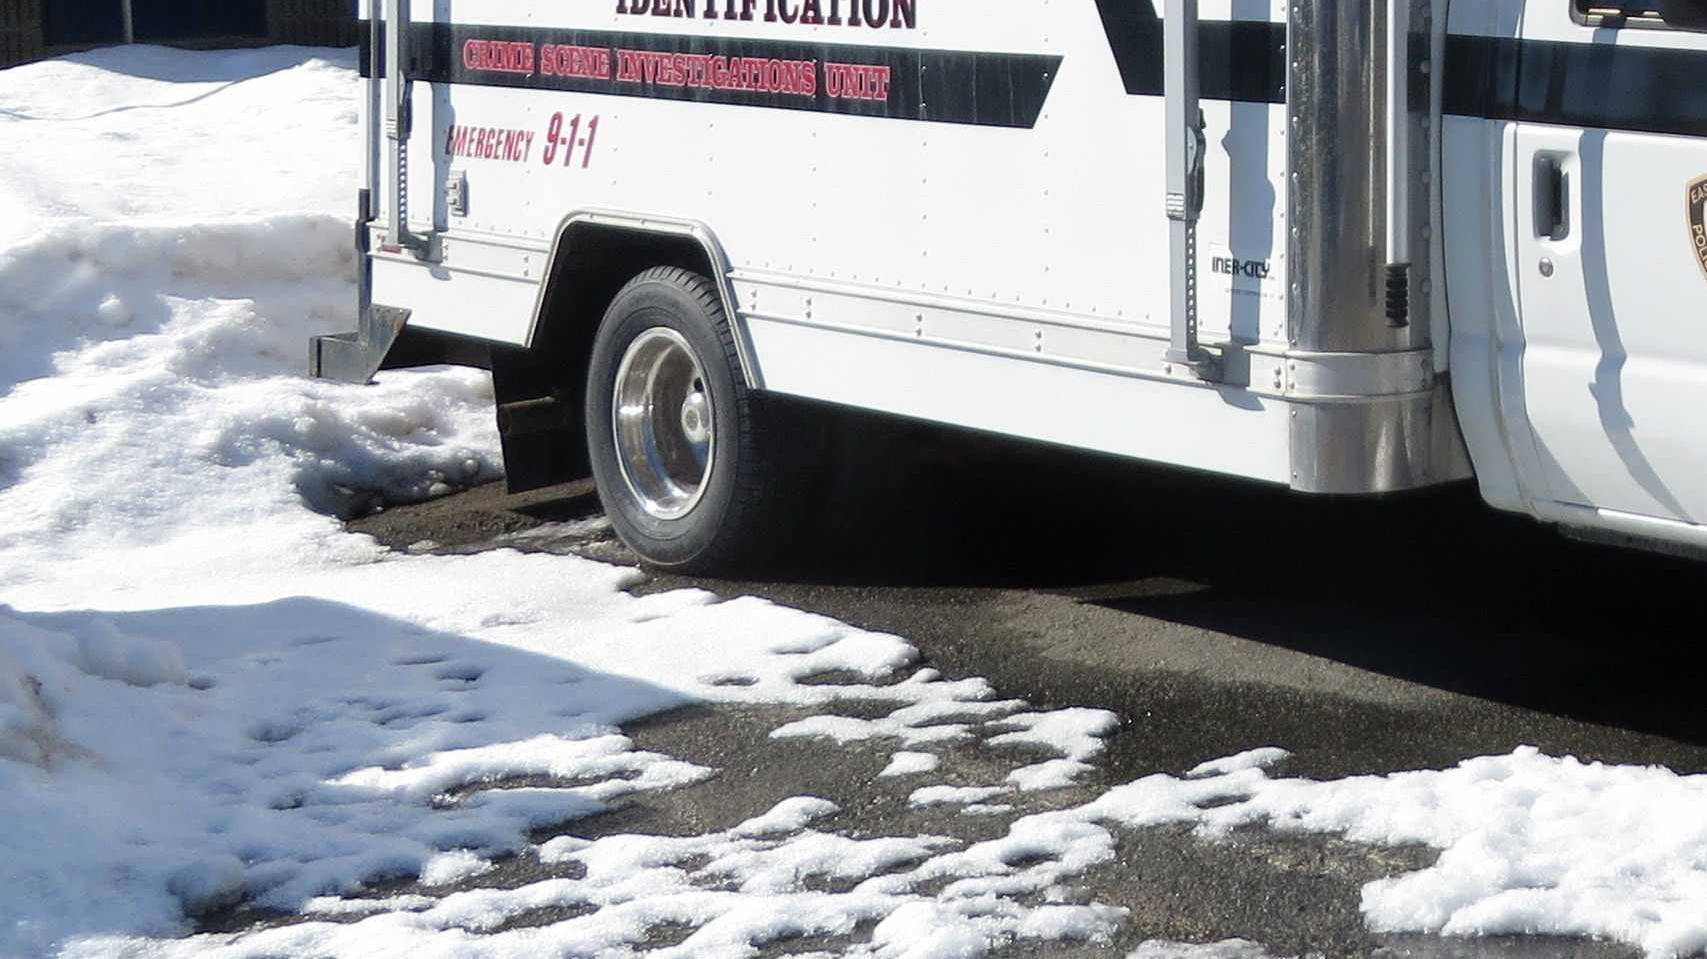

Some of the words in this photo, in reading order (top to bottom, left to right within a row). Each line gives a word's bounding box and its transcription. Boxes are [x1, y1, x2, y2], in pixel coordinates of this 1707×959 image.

[463, 39, 535, 73] CRIME
[540, 43, 611, 80] SCENE
[616, 48, 817, 97] INVESTIGATIONS
[823, 62, 891, 102] UNIT
[444, 124, 536, 163] EMERGENCY
[543, 111, 600, 169] 9-1-1
